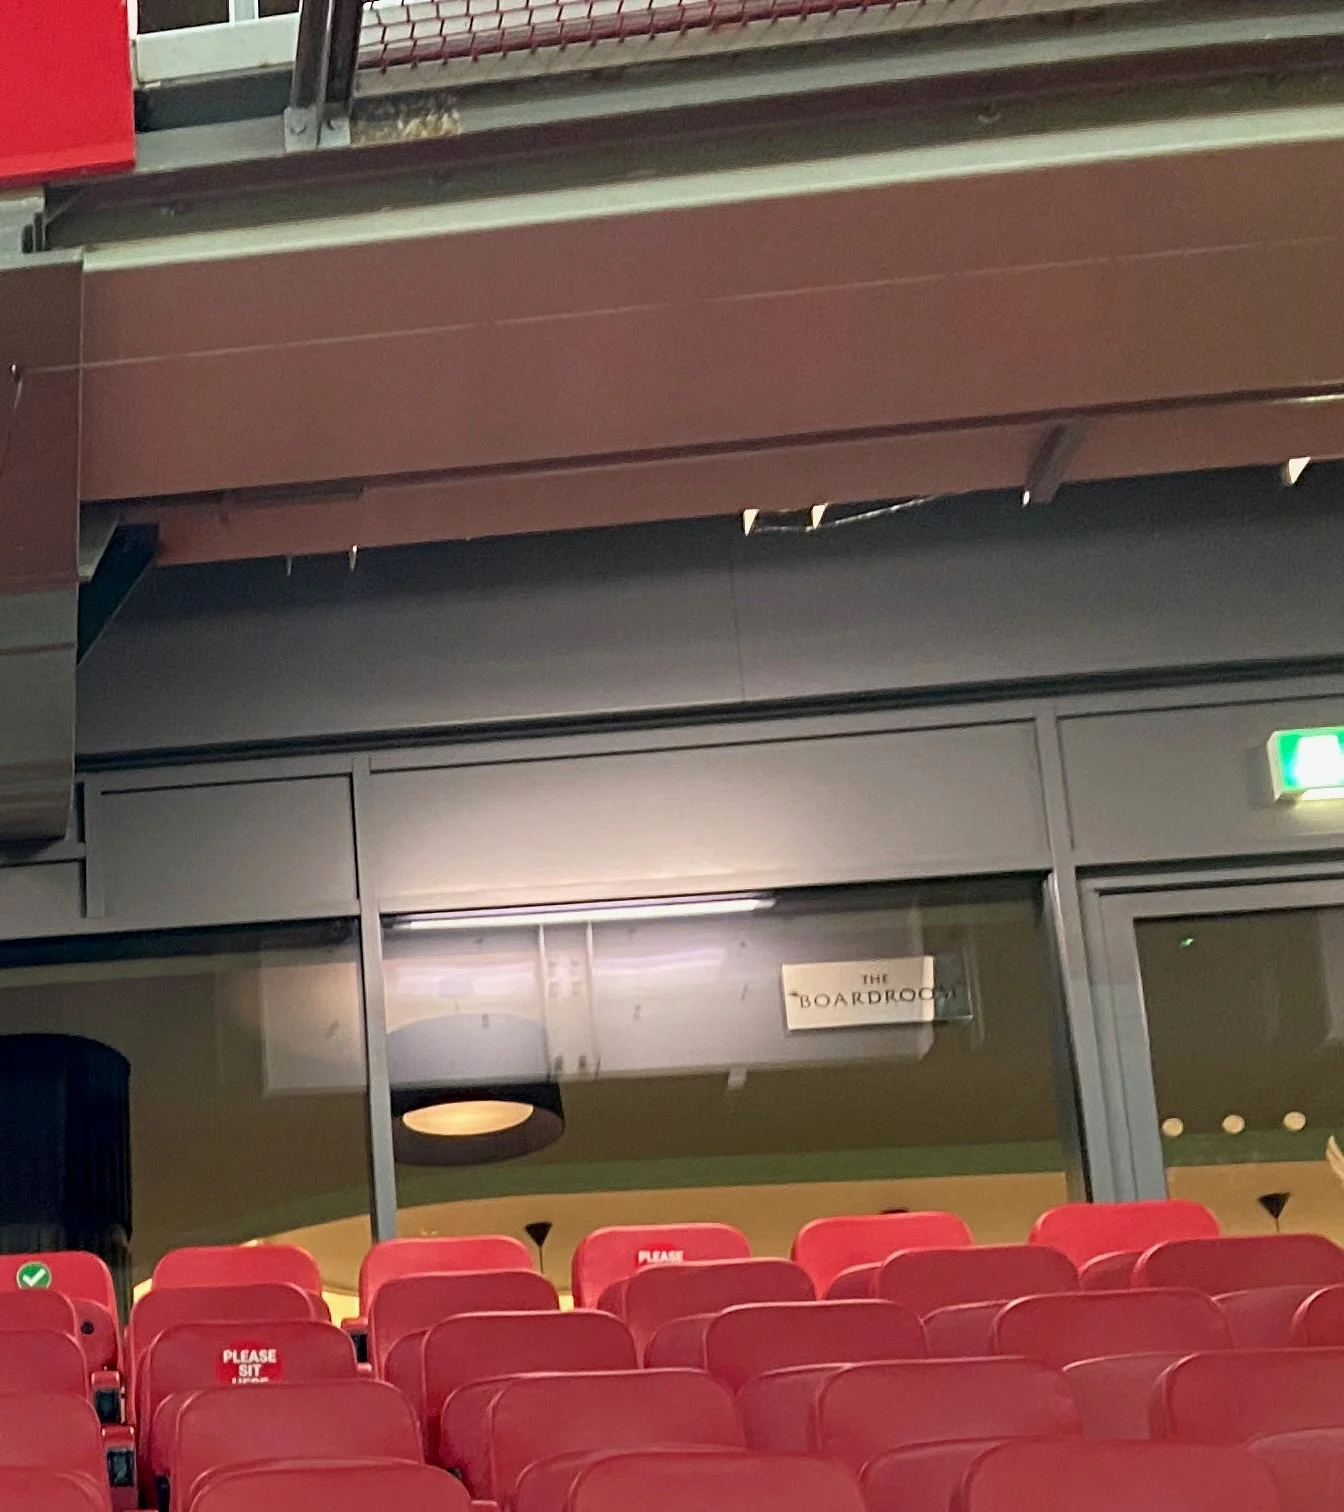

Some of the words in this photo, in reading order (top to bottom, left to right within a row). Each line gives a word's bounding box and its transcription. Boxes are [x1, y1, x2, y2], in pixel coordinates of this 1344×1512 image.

[862, 973, 889, 985] THE
[638, 1250, 684, 1264] PLEASE
[223, 1348, 277, 1364] PLEASE
[238, 1363, 262, 1377] SIT
